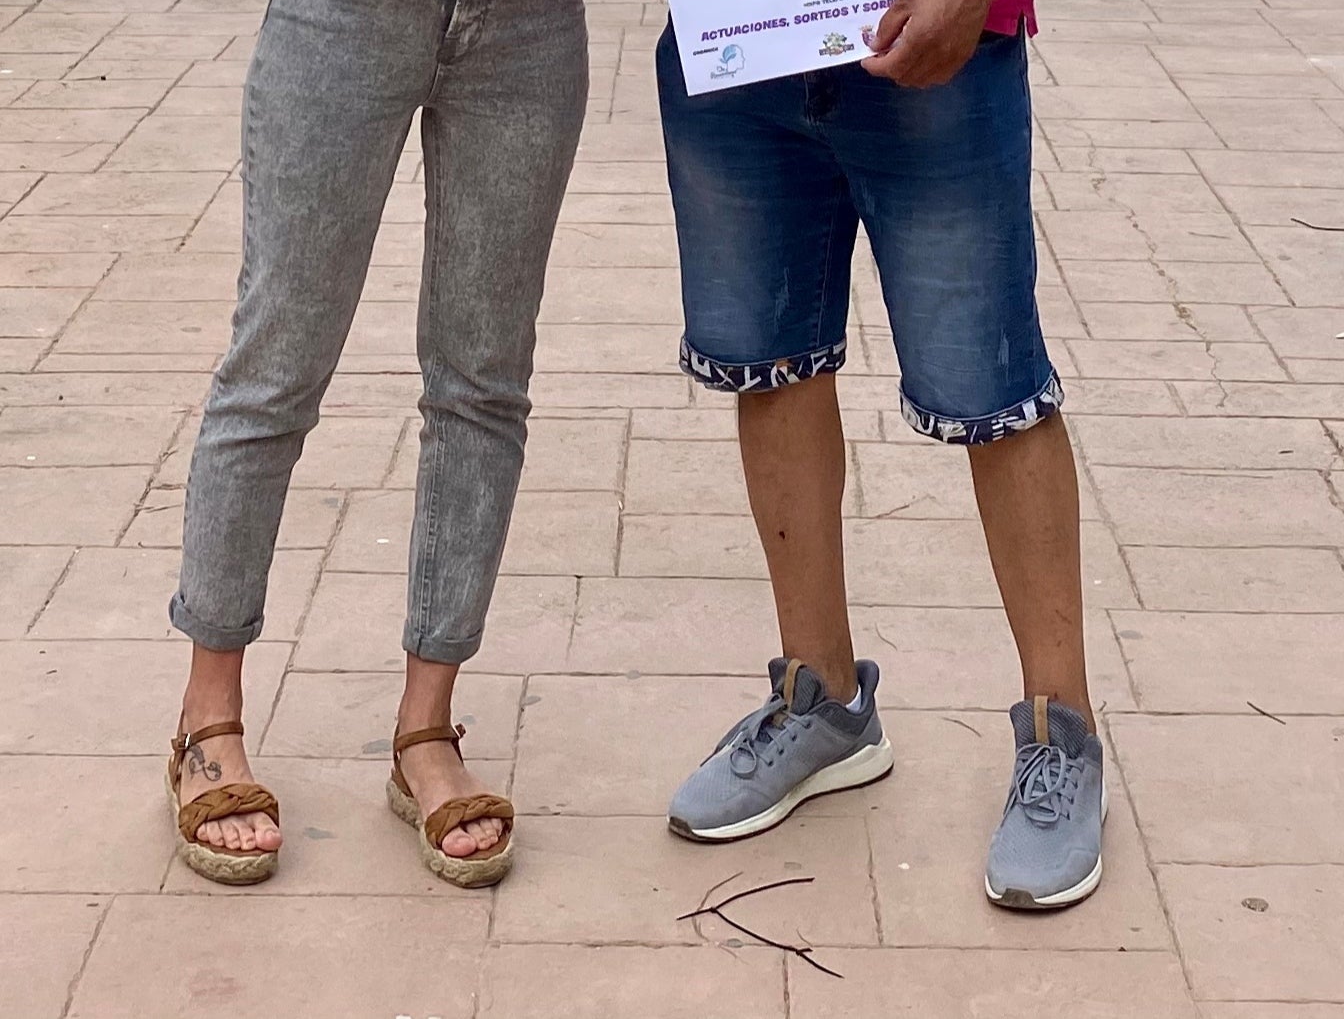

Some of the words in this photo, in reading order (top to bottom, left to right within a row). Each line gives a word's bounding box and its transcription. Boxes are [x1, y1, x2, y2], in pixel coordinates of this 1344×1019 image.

[701, 17, 790, 42] ACTUACIONES,
[793, 6, 849, 25] SORTEOS
[851, 4, 860, 14] Y
